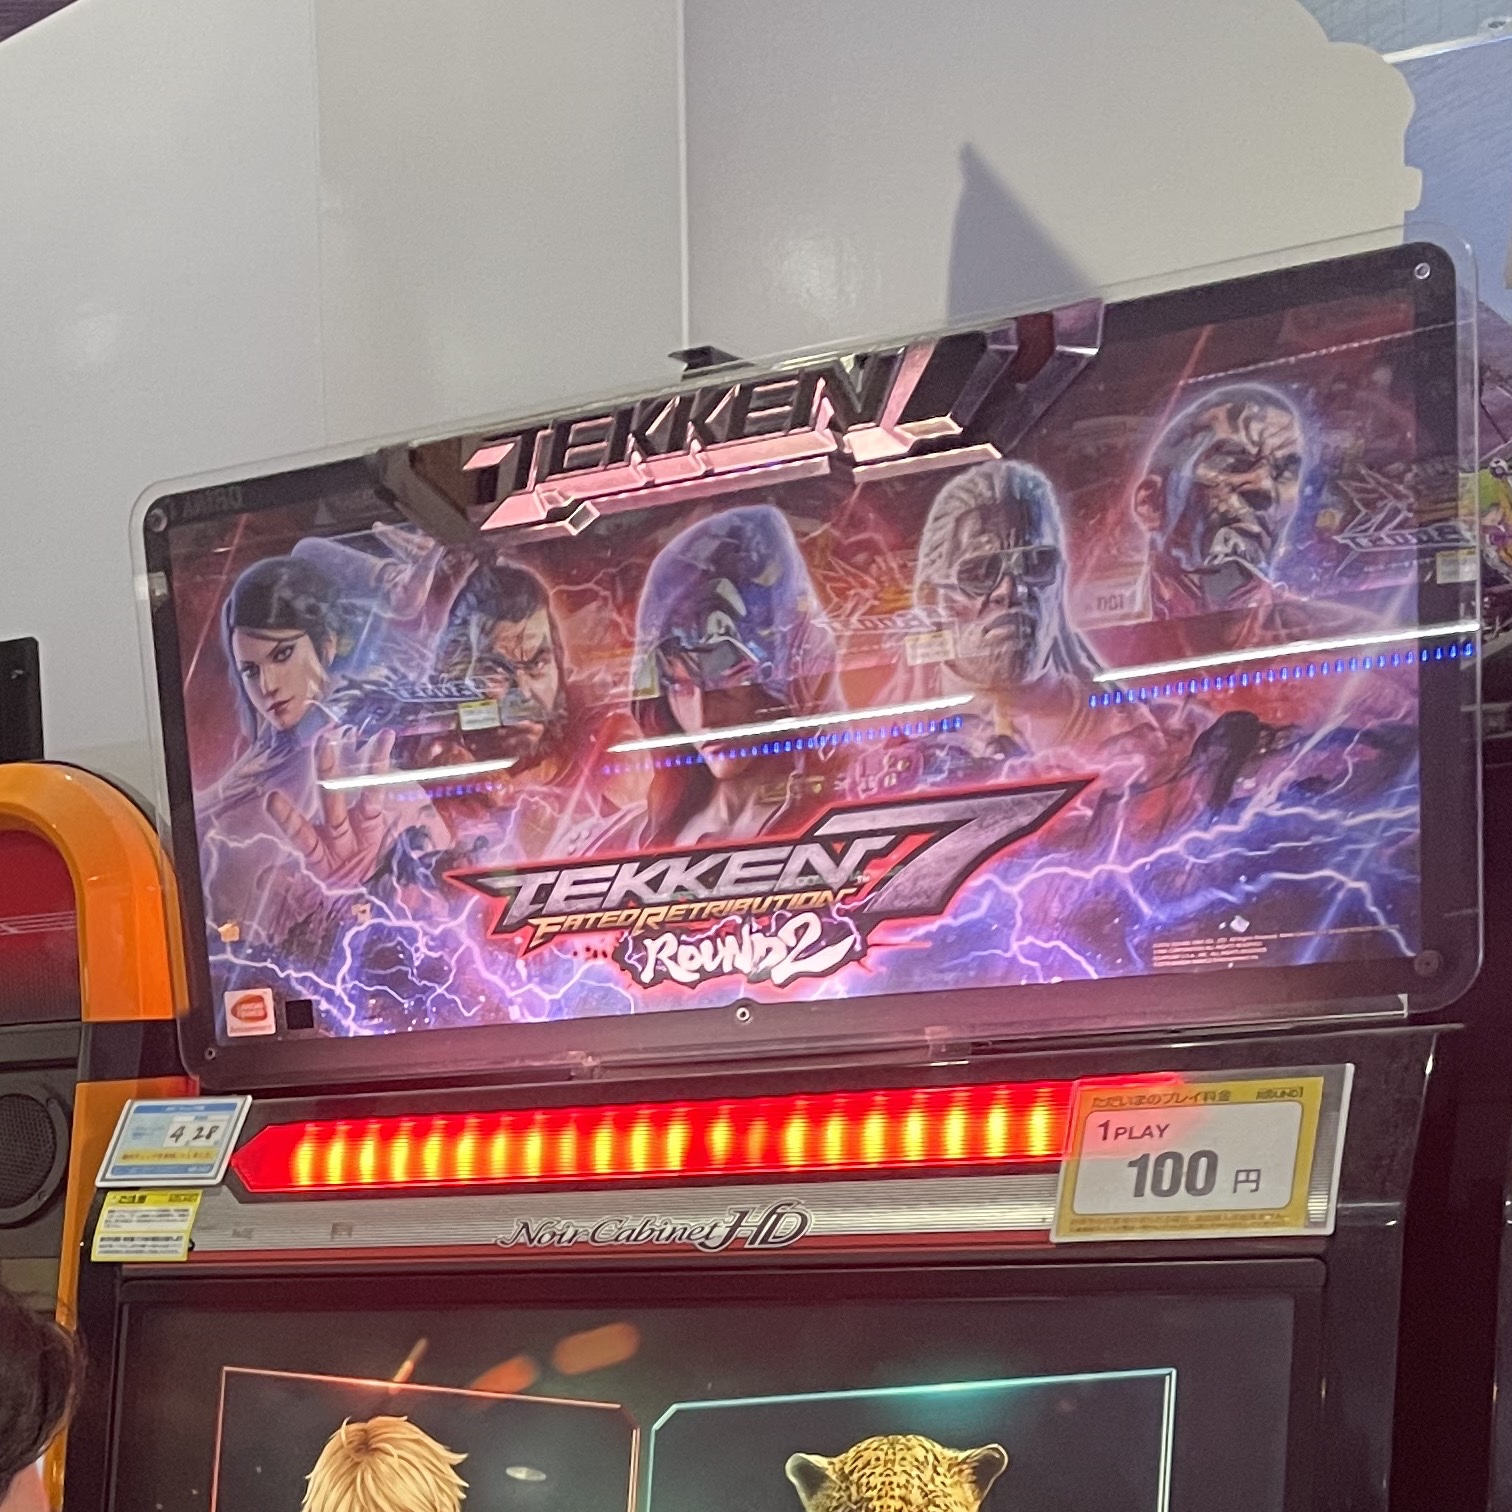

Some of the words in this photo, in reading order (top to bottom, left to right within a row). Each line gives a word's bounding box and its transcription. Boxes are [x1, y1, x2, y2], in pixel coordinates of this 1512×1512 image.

[488, 834, 890, 926] TEKKEN
[528, 908, 640, 947] FATED
[634, 887, 859, 934] RETRIBUTION
[642, 919, 786, 984] ROUND
[1127, 1149, 1219, 1198] 100
[1233, 1168, 1262, 1194] 円
[496, 1217, 588, 1248] Noir
[590, 1215, 720, 1246] Cabinet
[698, 1199, 812, 1252] HD
